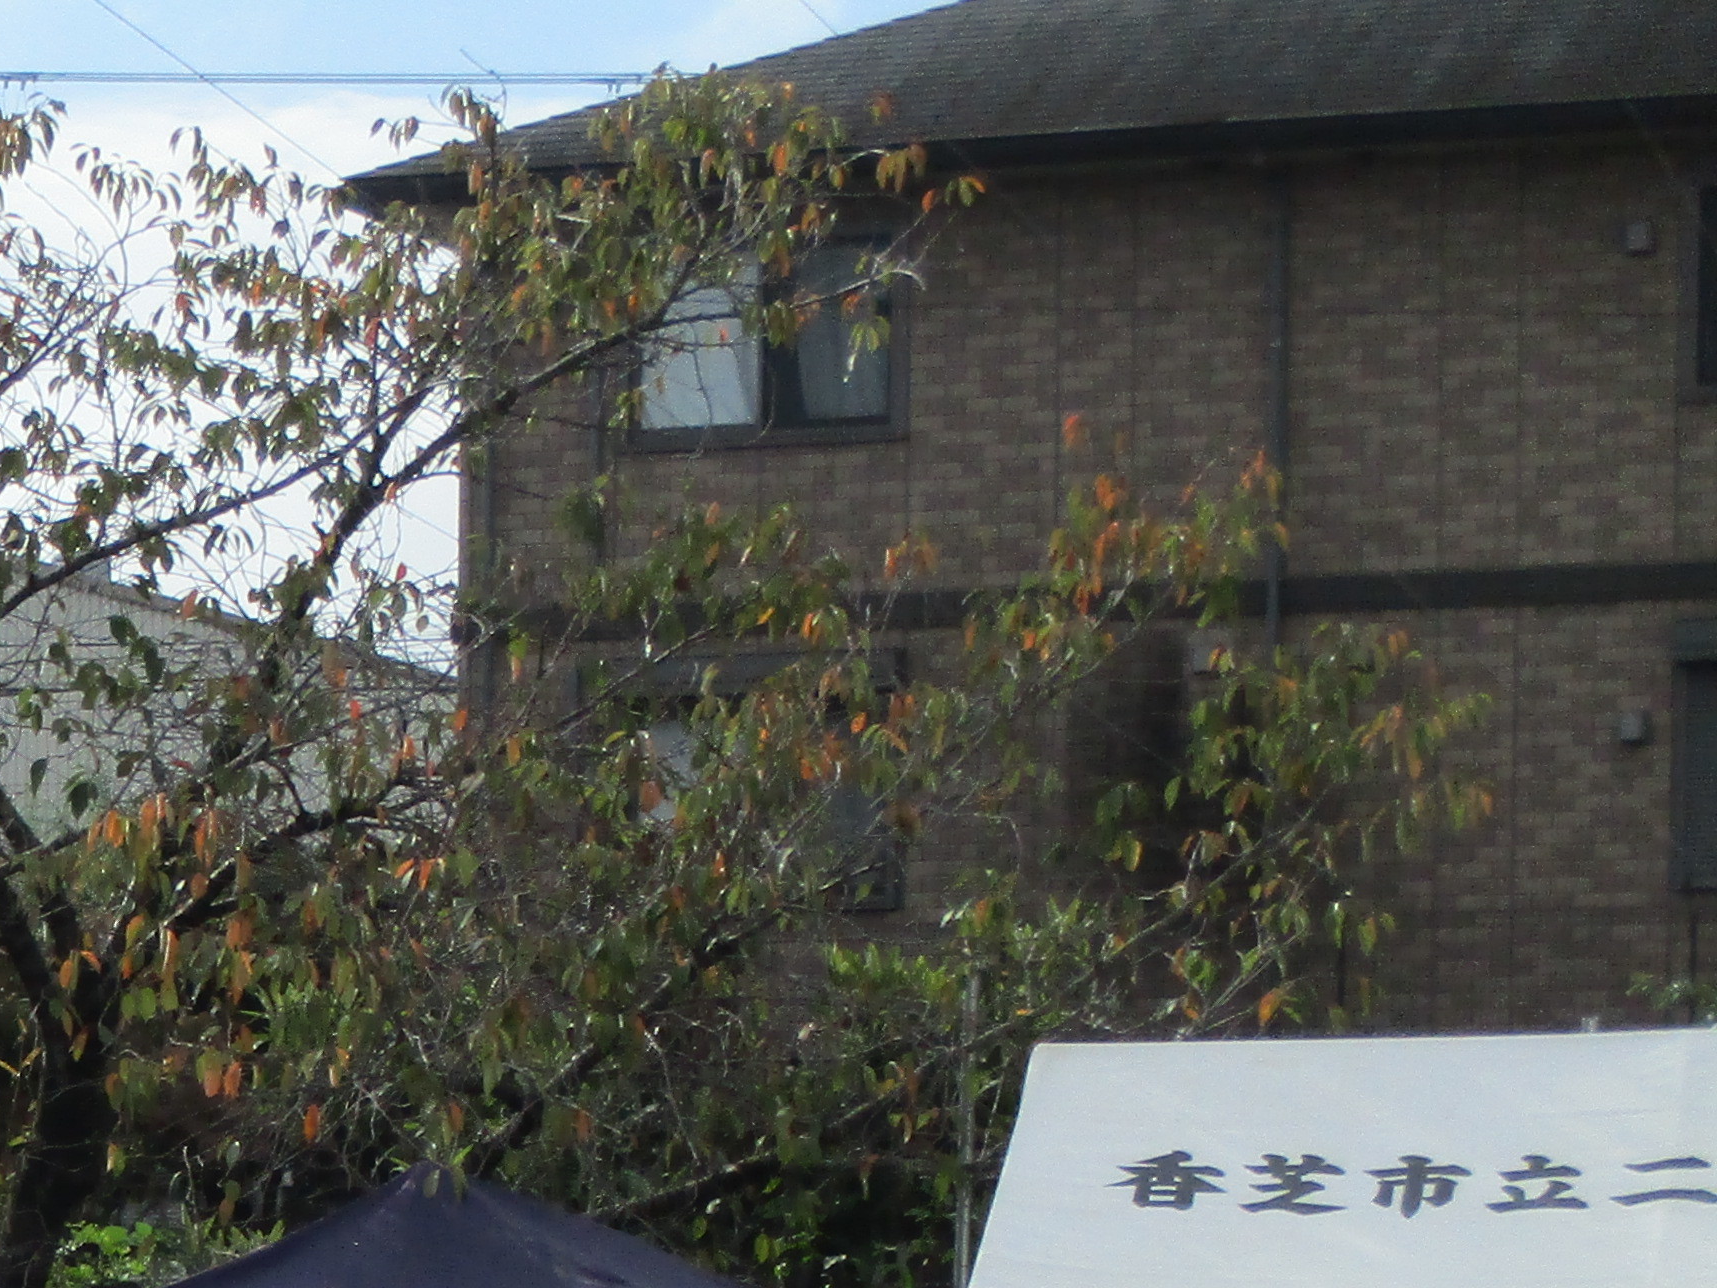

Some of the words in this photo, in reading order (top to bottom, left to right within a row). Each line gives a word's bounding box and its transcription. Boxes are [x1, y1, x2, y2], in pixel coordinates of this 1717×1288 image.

[1104, 1150, 1717, 1219] 香芝市立二
